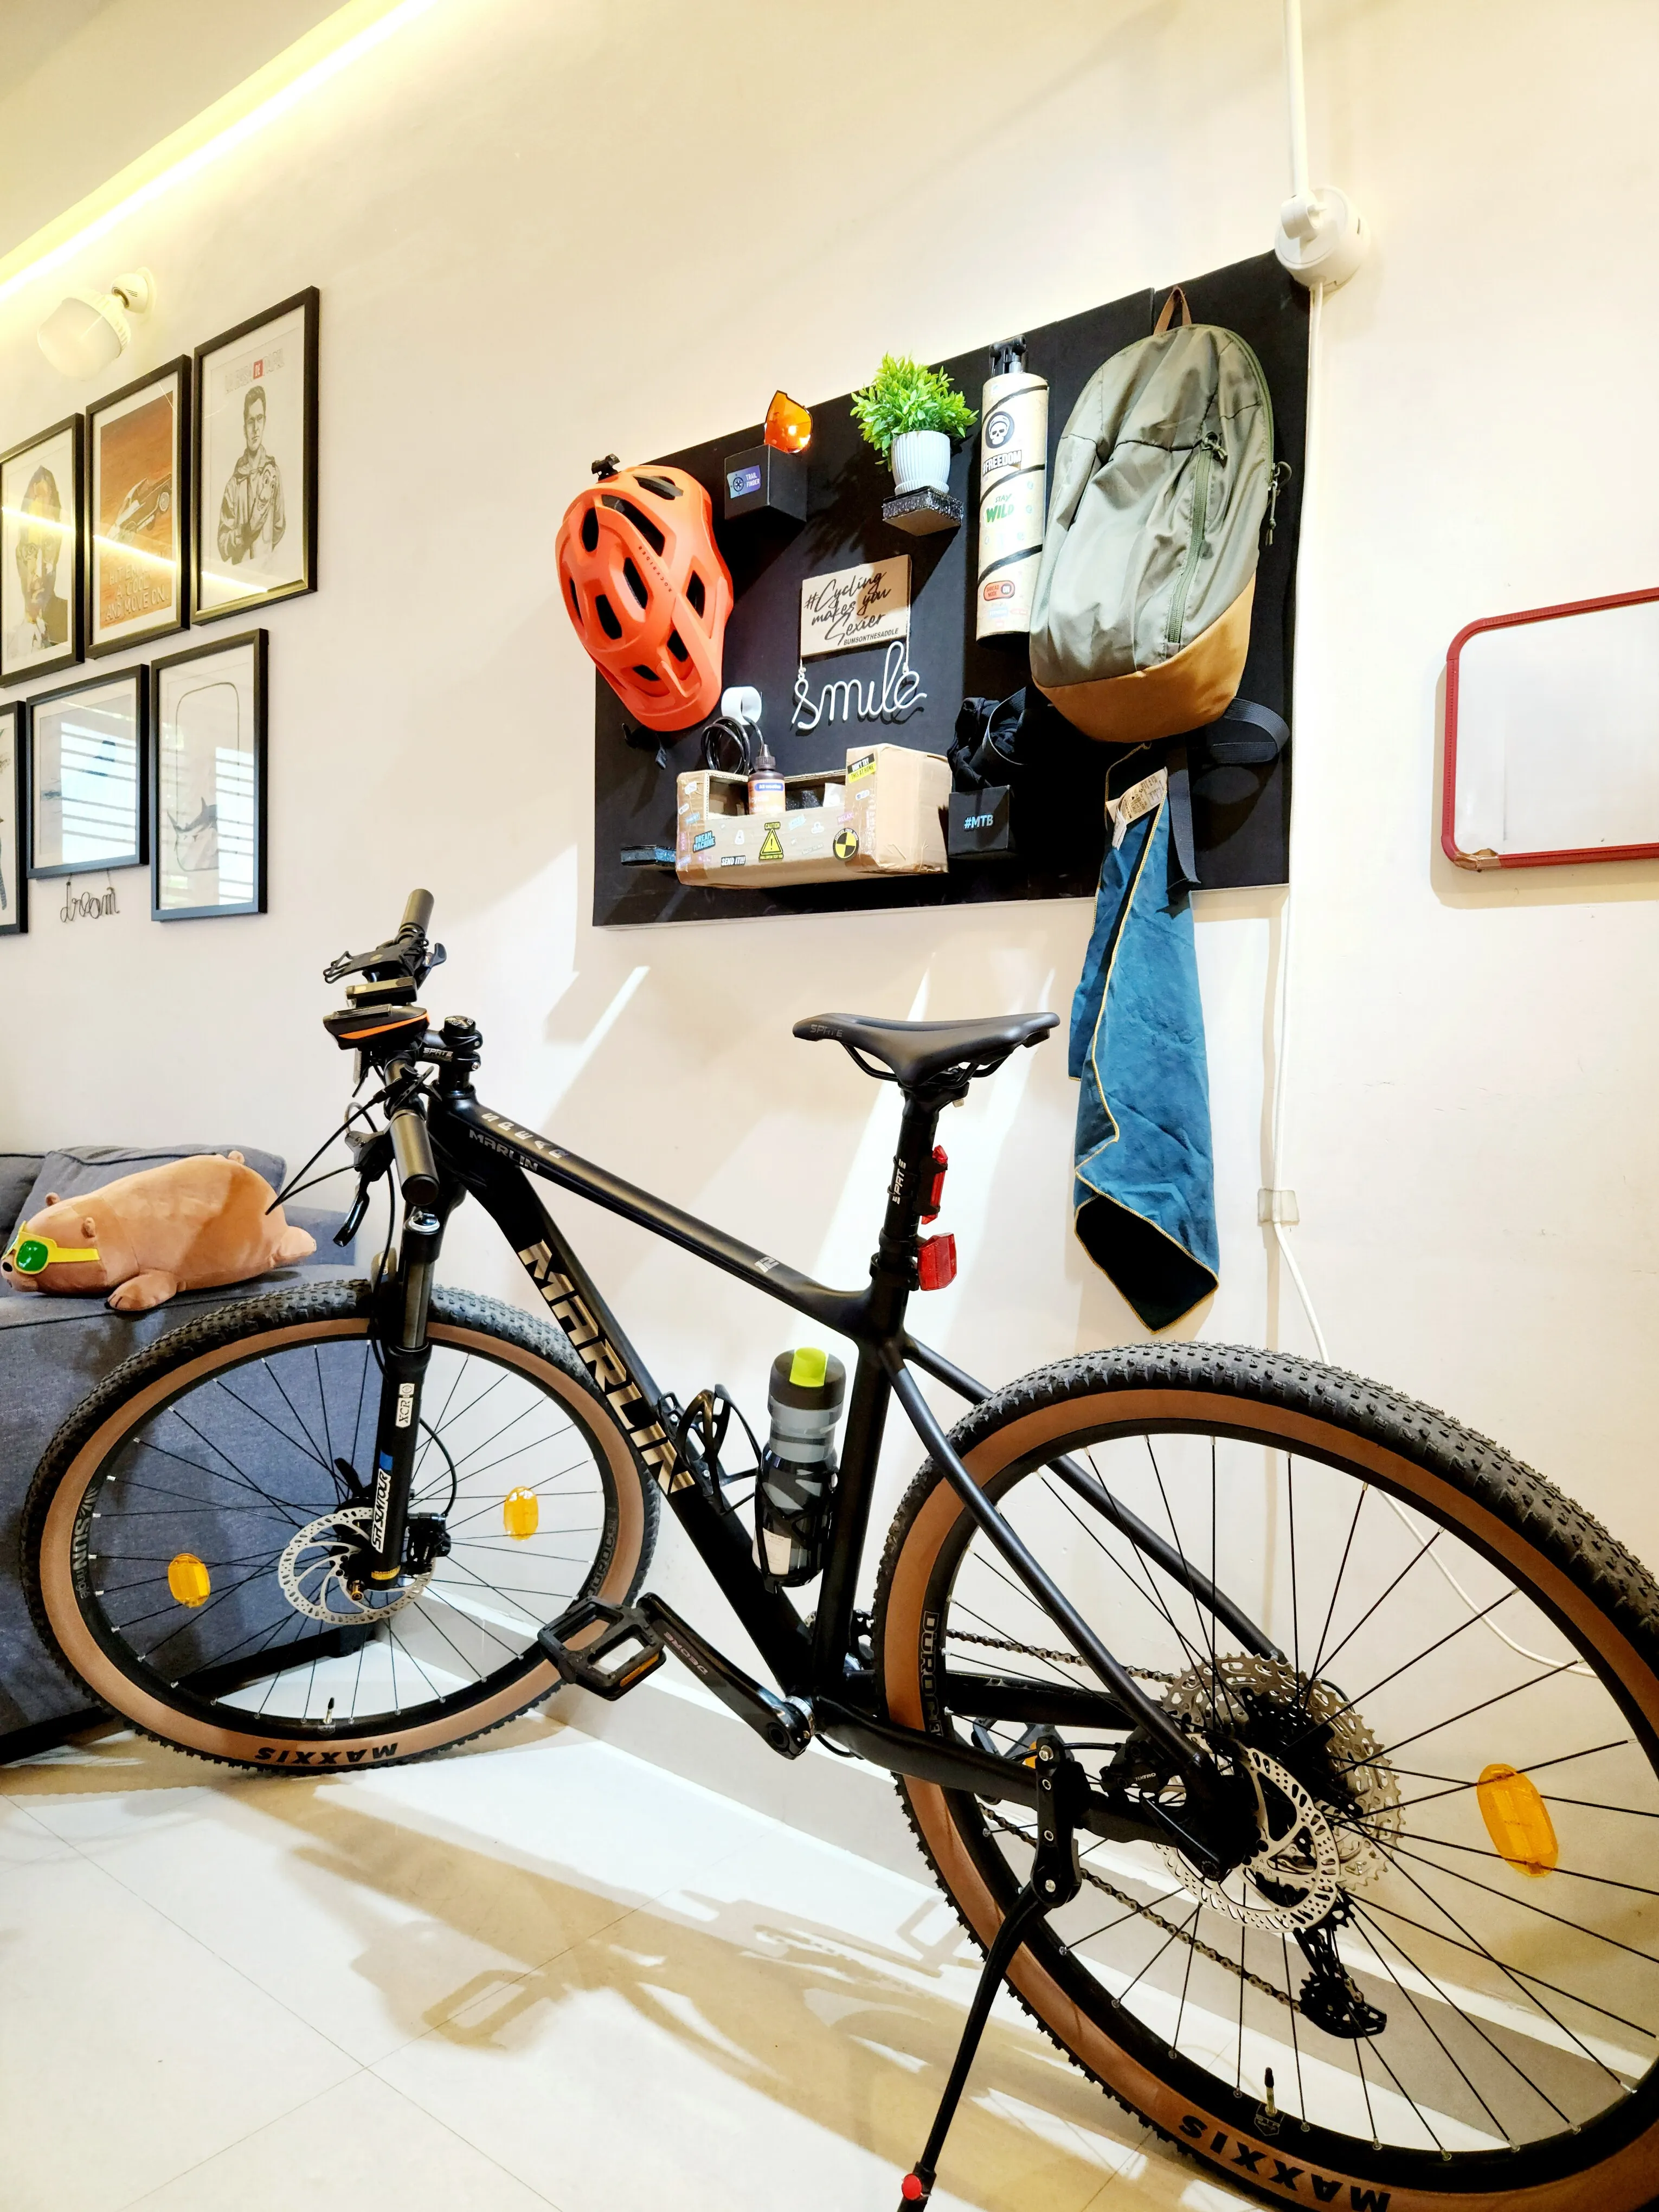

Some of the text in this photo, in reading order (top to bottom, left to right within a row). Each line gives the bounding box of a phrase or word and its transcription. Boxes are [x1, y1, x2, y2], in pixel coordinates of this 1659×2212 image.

[982, 450, 1022, 476] #FREEDOM
[745, 472, 757, 480] TRAIL
[747, 478, 760, 488] FINDER
[995, 493, 1012, 503] STAY
[986, 504, 1014, 523] WILD
[803, 570, 888, 613] #Cycling
[1002, 585, 1011, 594] ON
[105, 602, 121, 622] AND
[124, 591, 149, 615] MOVE
[812, 587, 892, 626] makes you
[824, 612, 888, 646] Sexier
[844, 627, 899, 646] BUMSONTHESADDLE
[792, 641, 928, 730] smile
[852, 761, 863, 771] DON'T
[864, 764, 874, 773] HOME
[838, 813, 853, 822] RELAX
[964, 814, 993, 829] #MTB
[693, 839, 715, 852] MACHINE
[695, 832, 712, 844] DREAM
[721, 858, 735, 866] SEND
[60, 882, 120, 923] dream
[481, 1113, 570, 1159] SPEAR
[469, 1129, 538, 1172] MARLIN
[518, 1239, 695, 1495] MARLIN
[398, 1399, 411, 1424] XCR
[374, 1470, 389, 1528] SUNTOUR
[254, 1742, 398, 1765] MAXXIS
[1178, 2115, 1391, 2212] MAXXIS
